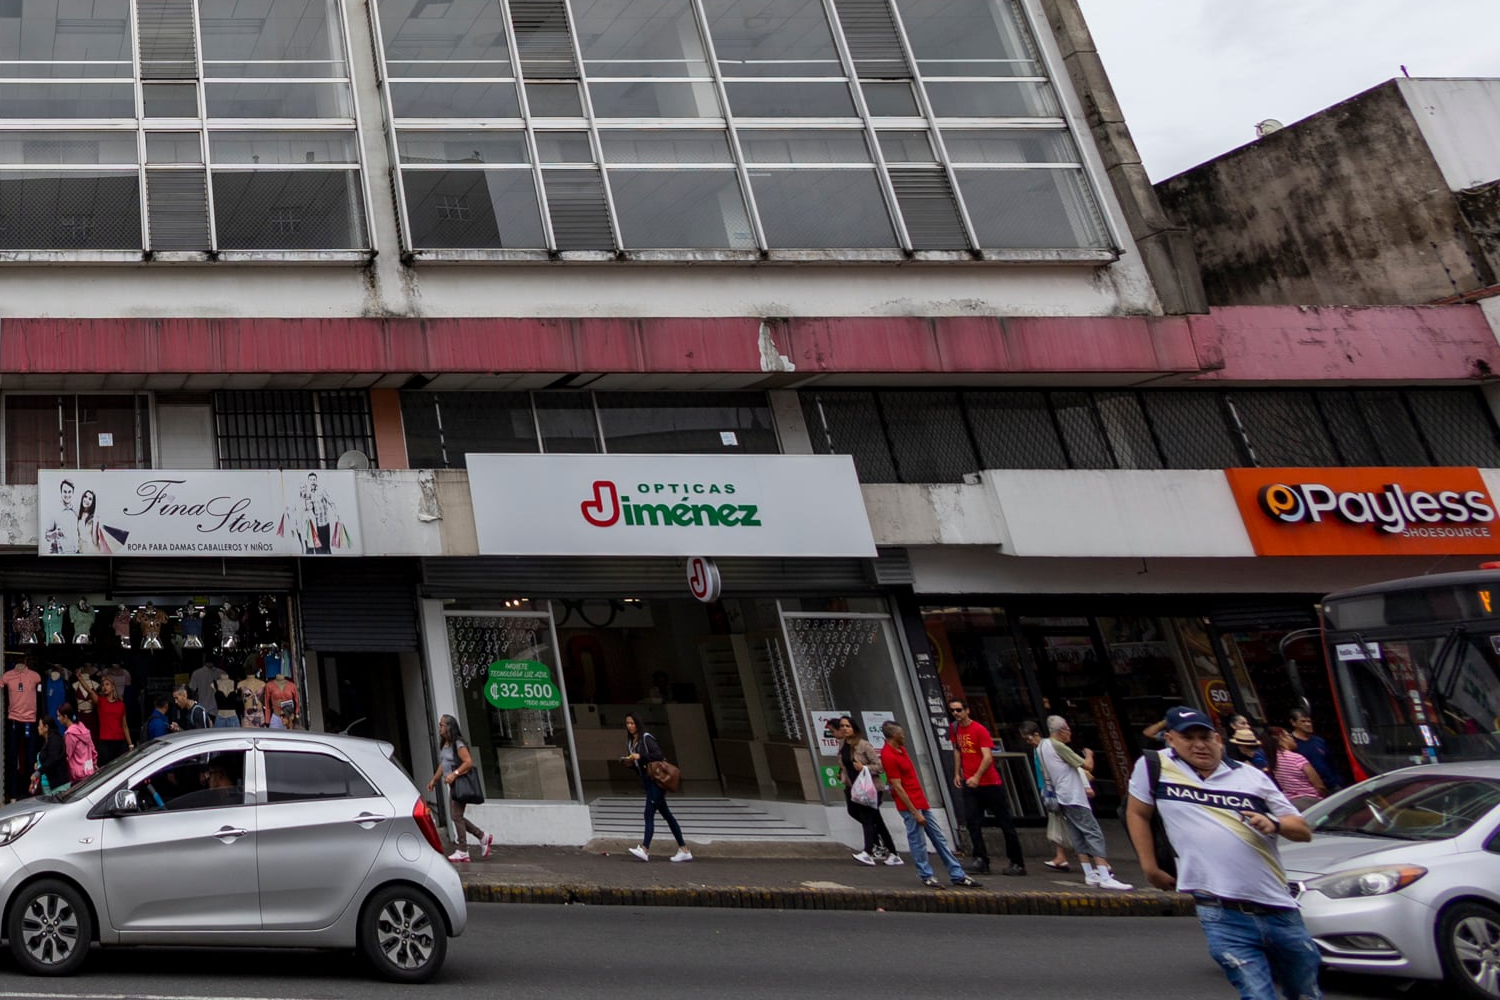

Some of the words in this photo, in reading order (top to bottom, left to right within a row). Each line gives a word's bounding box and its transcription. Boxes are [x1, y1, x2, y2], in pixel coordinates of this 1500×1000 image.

[637, 483, 736, 494] OPTICAS
[122, 479, 206, 516] Fina
[196, 496, 274, 533] Store
[580, 480, 762, 528] Jiménez
[1299, 483, 1495, 534] Payless
[1402, 527, 1491, 538] SHOESOURCE
[127, 543, 148, 551] ROPA
[149, 543, 167, 551] PARA
[169, 543, 196, 551] DAMAS
[199, 543, 242, 551] CABALLEROS
[243, 543, 248, 551] Y
[250, 541, 273, 551] NIÑOS
[1351, 732, 1371, 745] 310
[1166, 786, 1256, 810] NAUTICA
